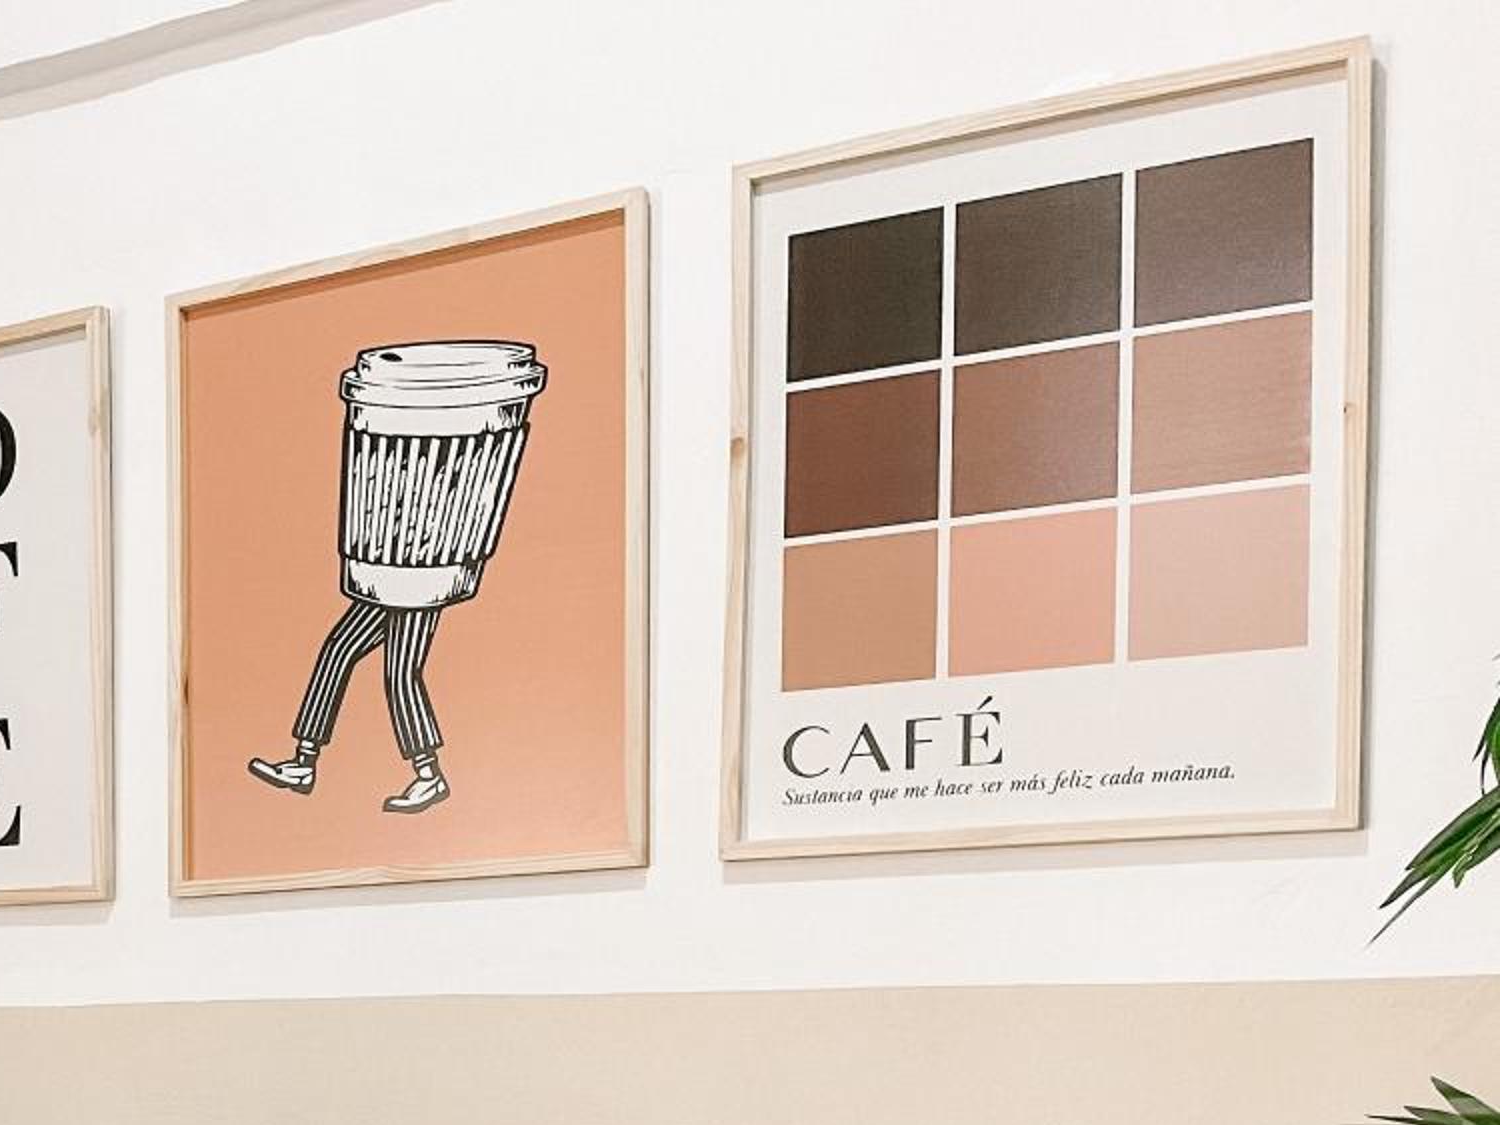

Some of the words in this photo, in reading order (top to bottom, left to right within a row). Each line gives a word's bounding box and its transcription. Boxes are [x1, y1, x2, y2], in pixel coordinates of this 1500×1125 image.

[782, 695, 1004, 779] CAFÉ
[782, 787, 863, 805] Sustancia
[869, 786, 899, 806] que
[904, 784, 929, 798] me
[934, 778, 973, 796] hace
[981, 779, 1004, 793] ser
[1010, 773, 1046, 792] más
[1047, 769, 1094, 795] feliz
[1099, 765, 1145, 786] cada
[1151, 764, 1235, 783] mañana.
